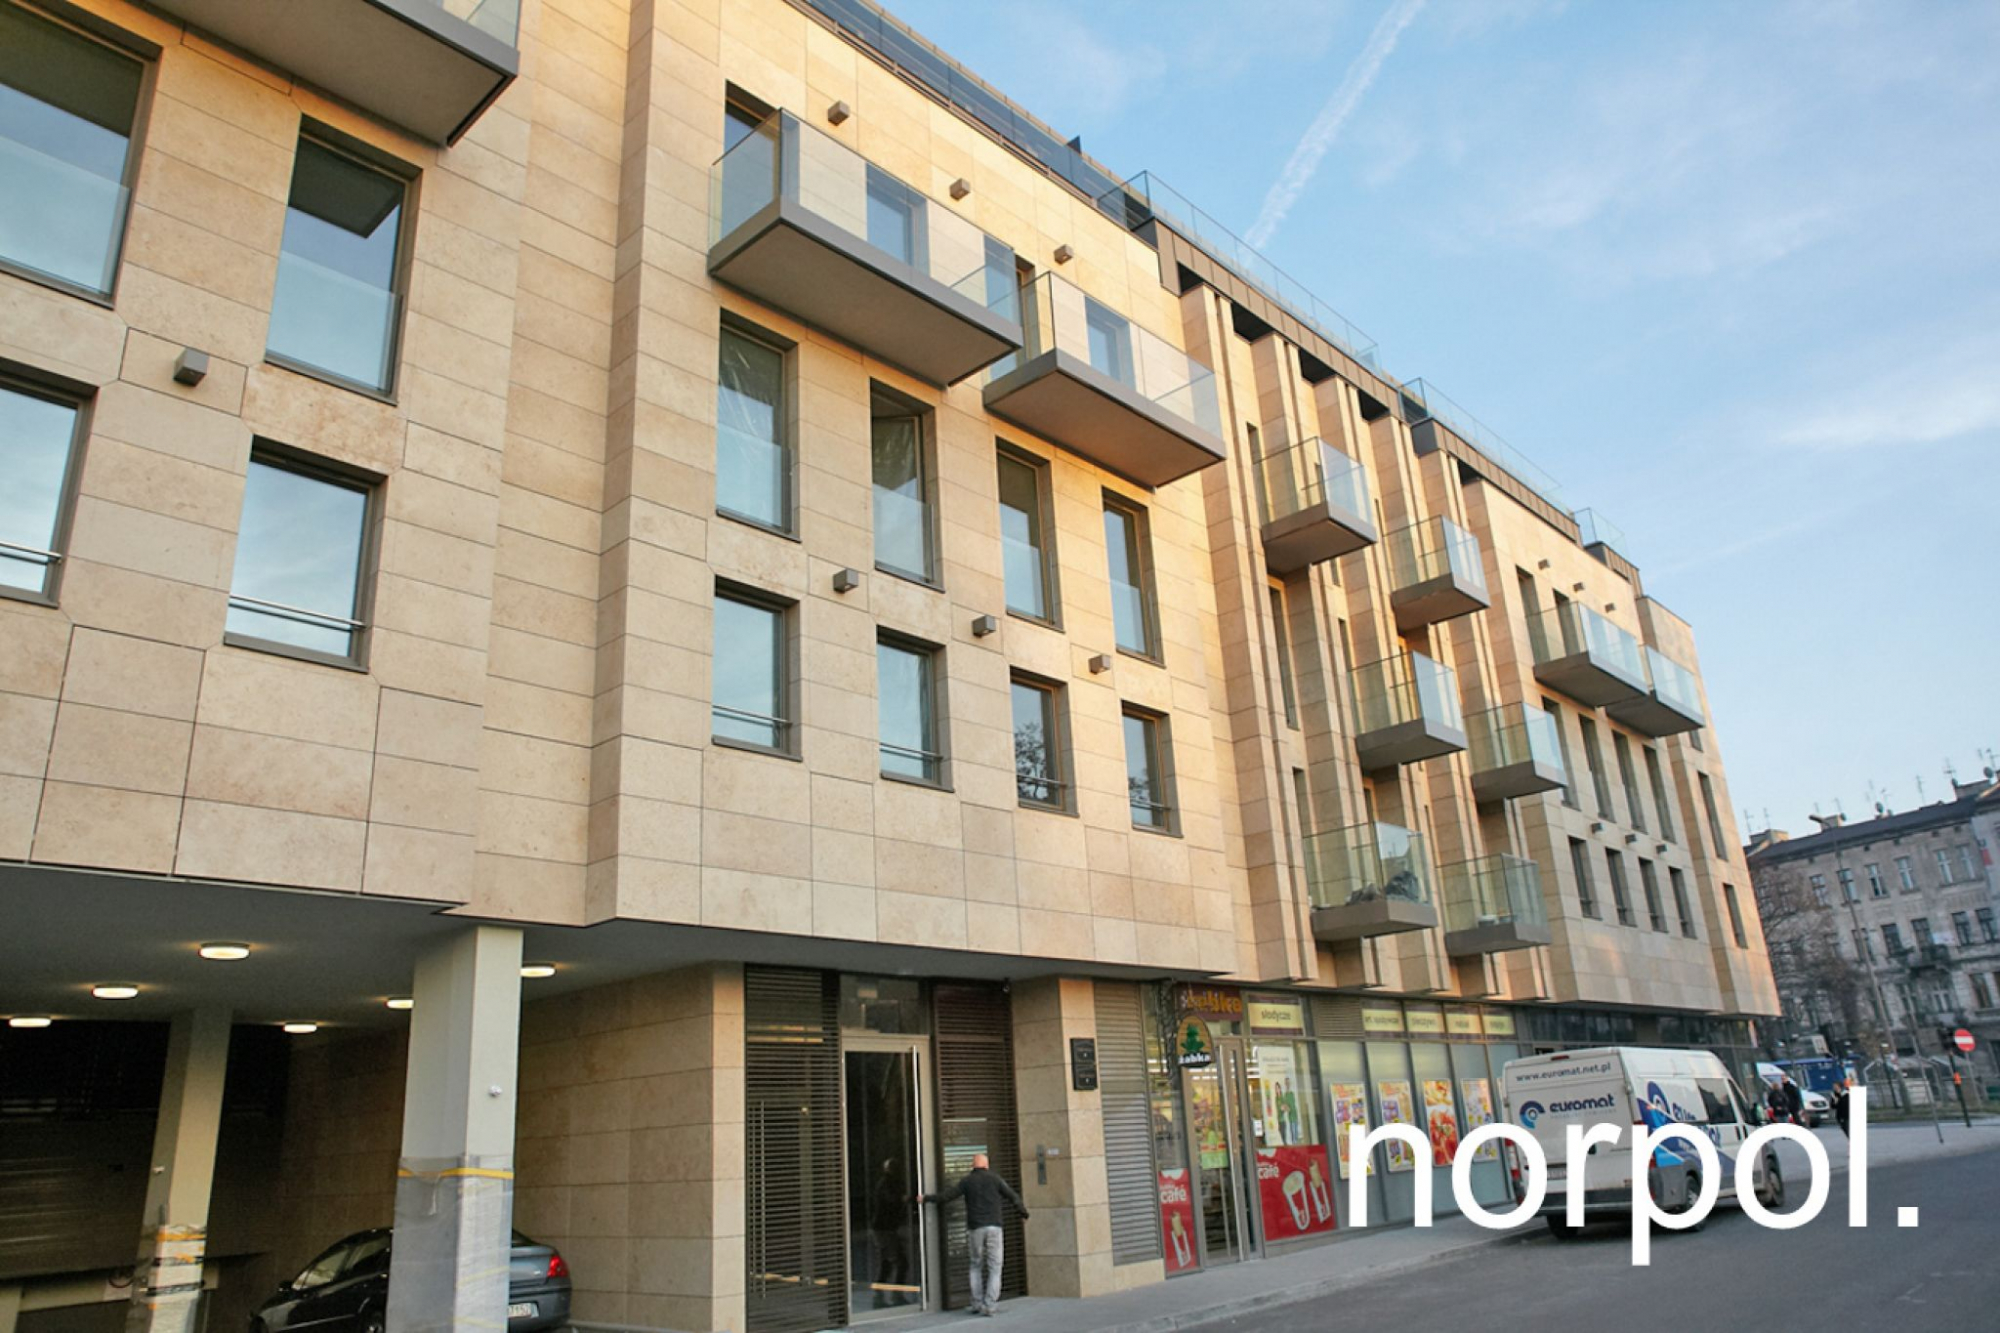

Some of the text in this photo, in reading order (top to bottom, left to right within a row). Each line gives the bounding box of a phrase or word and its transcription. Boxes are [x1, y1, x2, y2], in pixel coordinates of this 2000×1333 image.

[1516, 1063, 1611, 1081] www.euromat.net.pl
[1550, 1094, 1614, 1113] euromat
[1160, 1186, 1187, 1203] café
